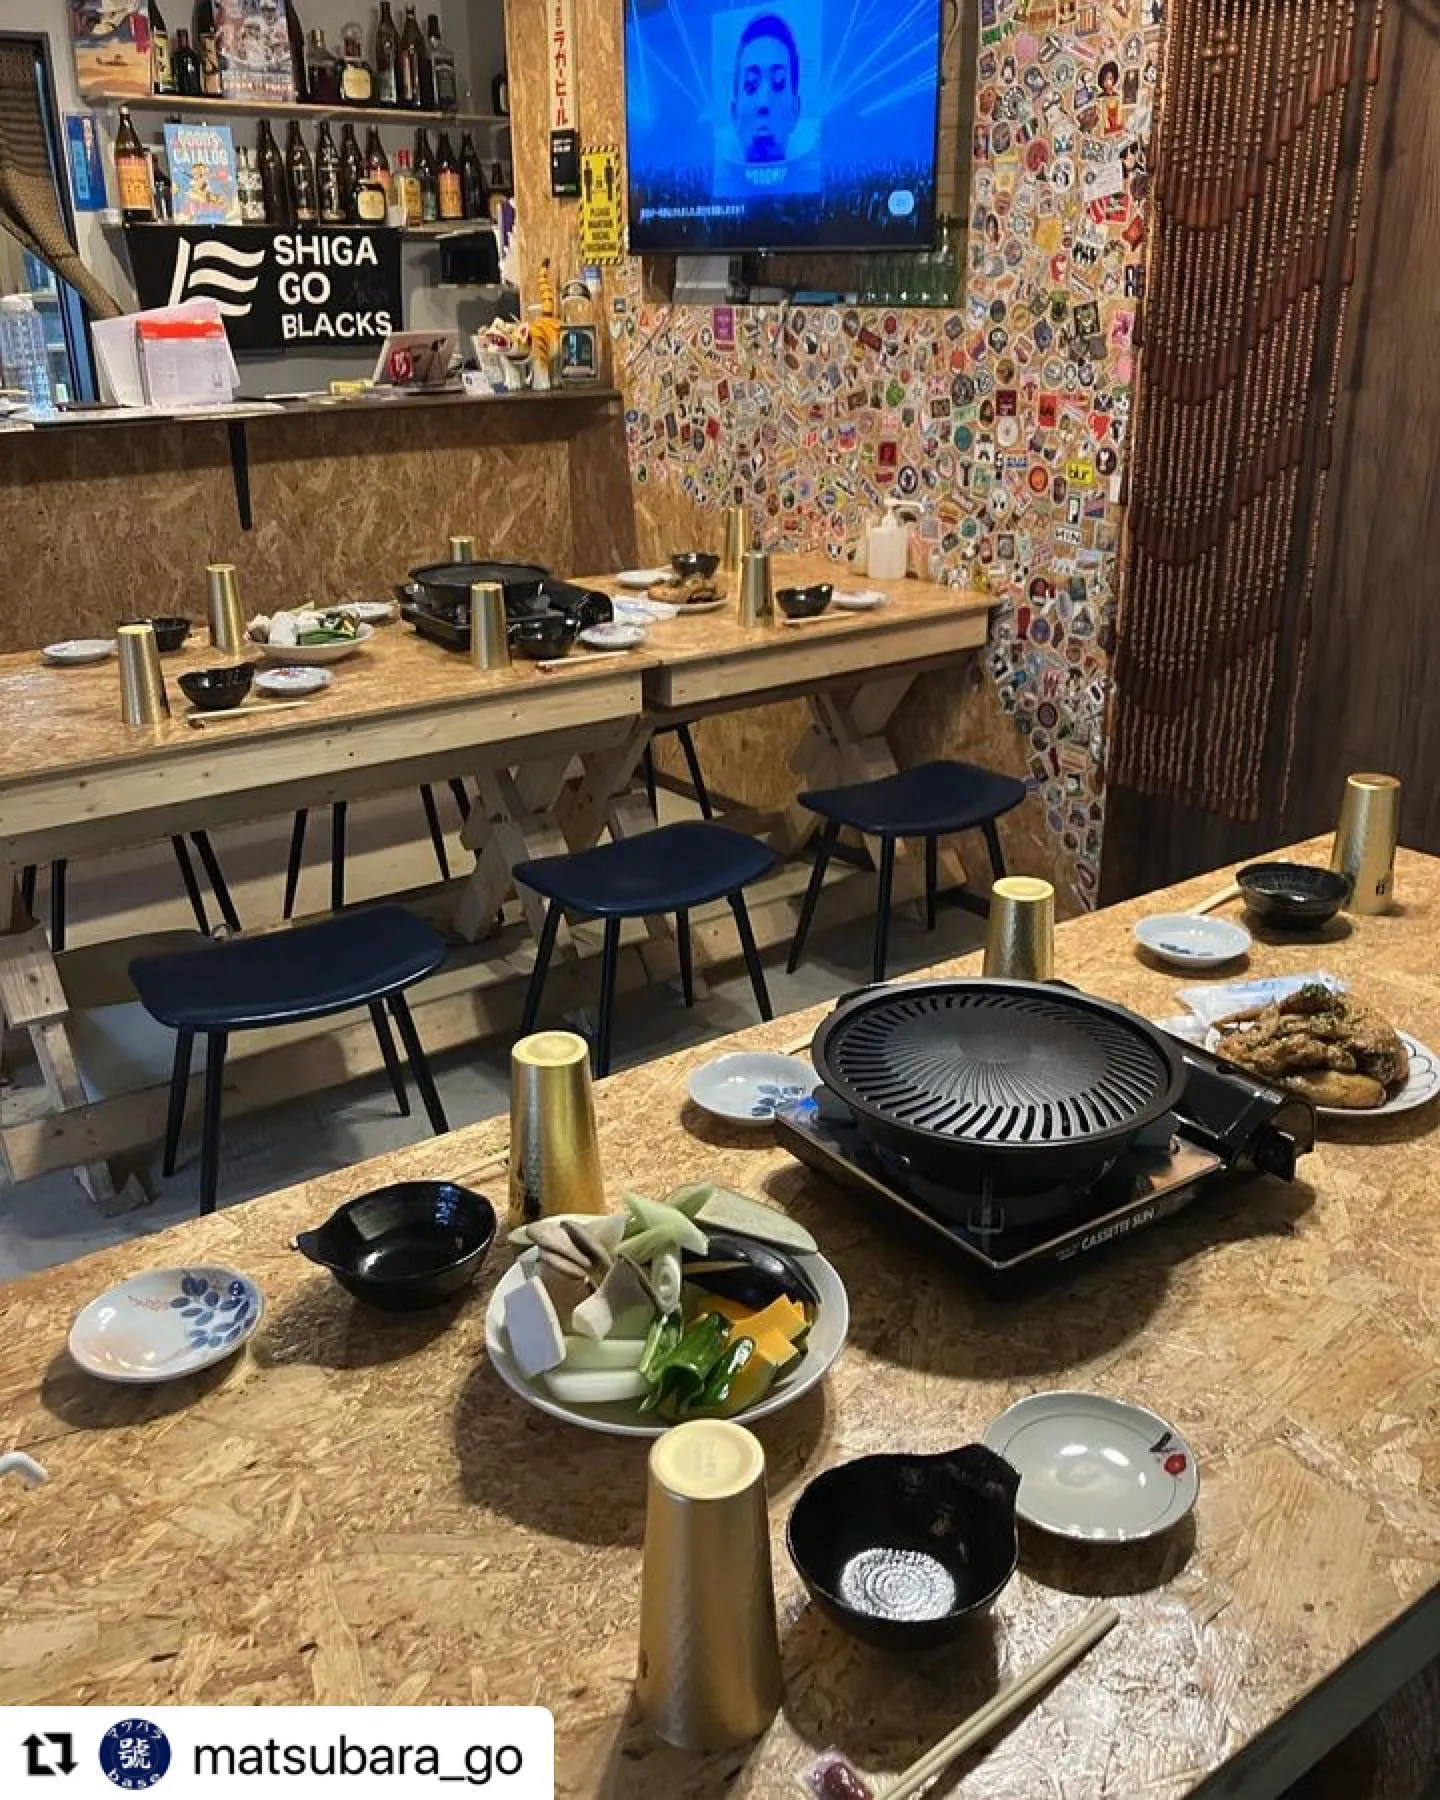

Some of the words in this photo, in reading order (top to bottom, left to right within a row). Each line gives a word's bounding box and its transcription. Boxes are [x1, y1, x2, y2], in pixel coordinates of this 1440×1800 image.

[273, 234, 379, 266] SHIGA
[278, 271, 331, 305] GO
[281, 310, 393, 339] BLACKS
